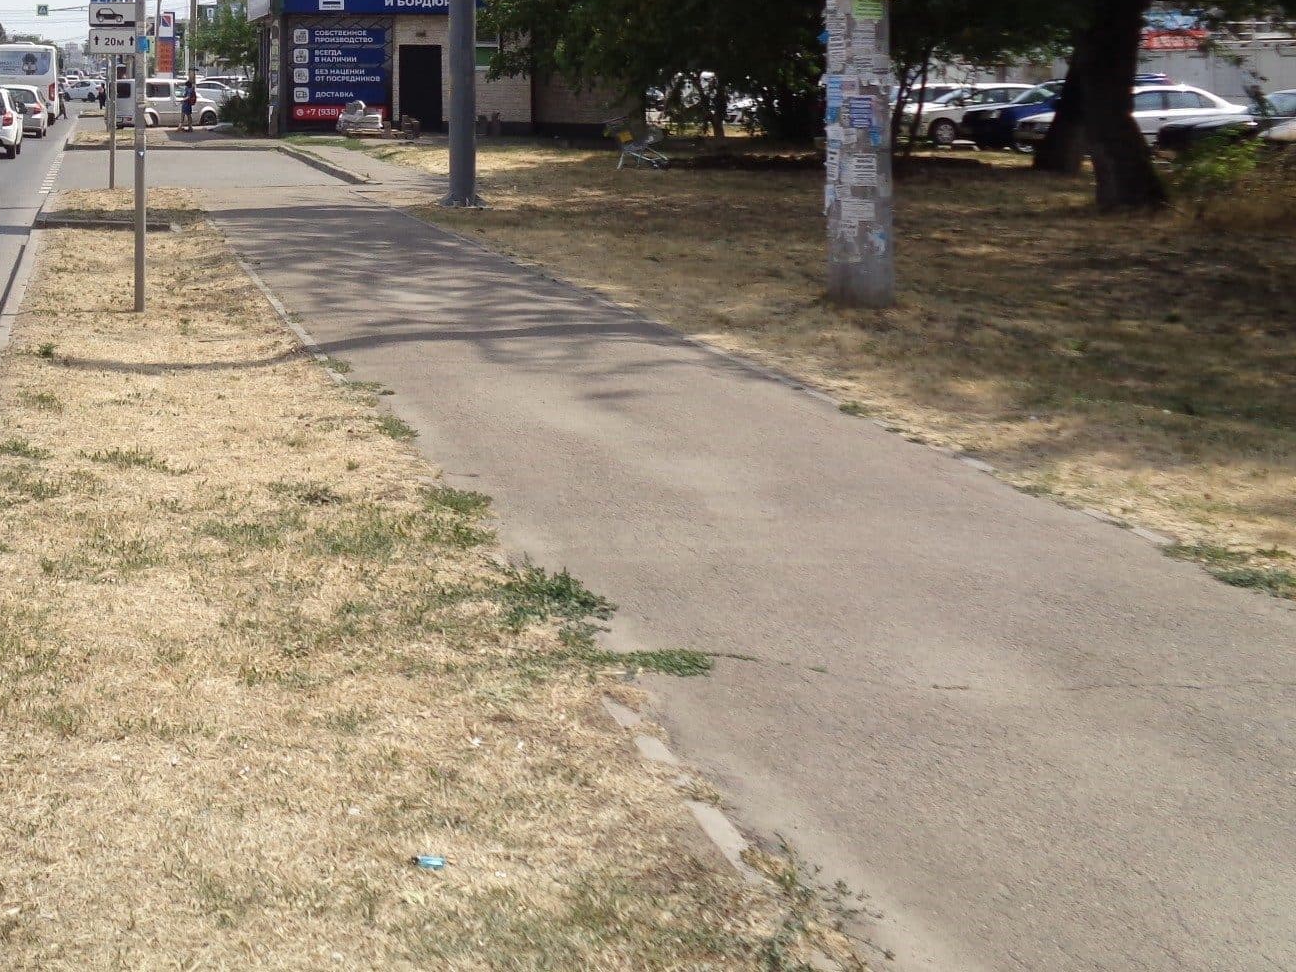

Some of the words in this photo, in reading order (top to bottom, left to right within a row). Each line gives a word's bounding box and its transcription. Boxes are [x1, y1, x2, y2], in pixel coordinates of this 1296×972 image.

[314, 36, 374, 44] ПРОИЗВОДСТВО
[314, 49, 342, 57] ВСЕГДА
[330, 68, 365, 76] НАЦЕНКИ
[326, 75, 381, 83] ПОСРЕДНИКОВ
[315, 91, 354, 99] ДОСТАВКА
[306, 108, 316, 116] +7
